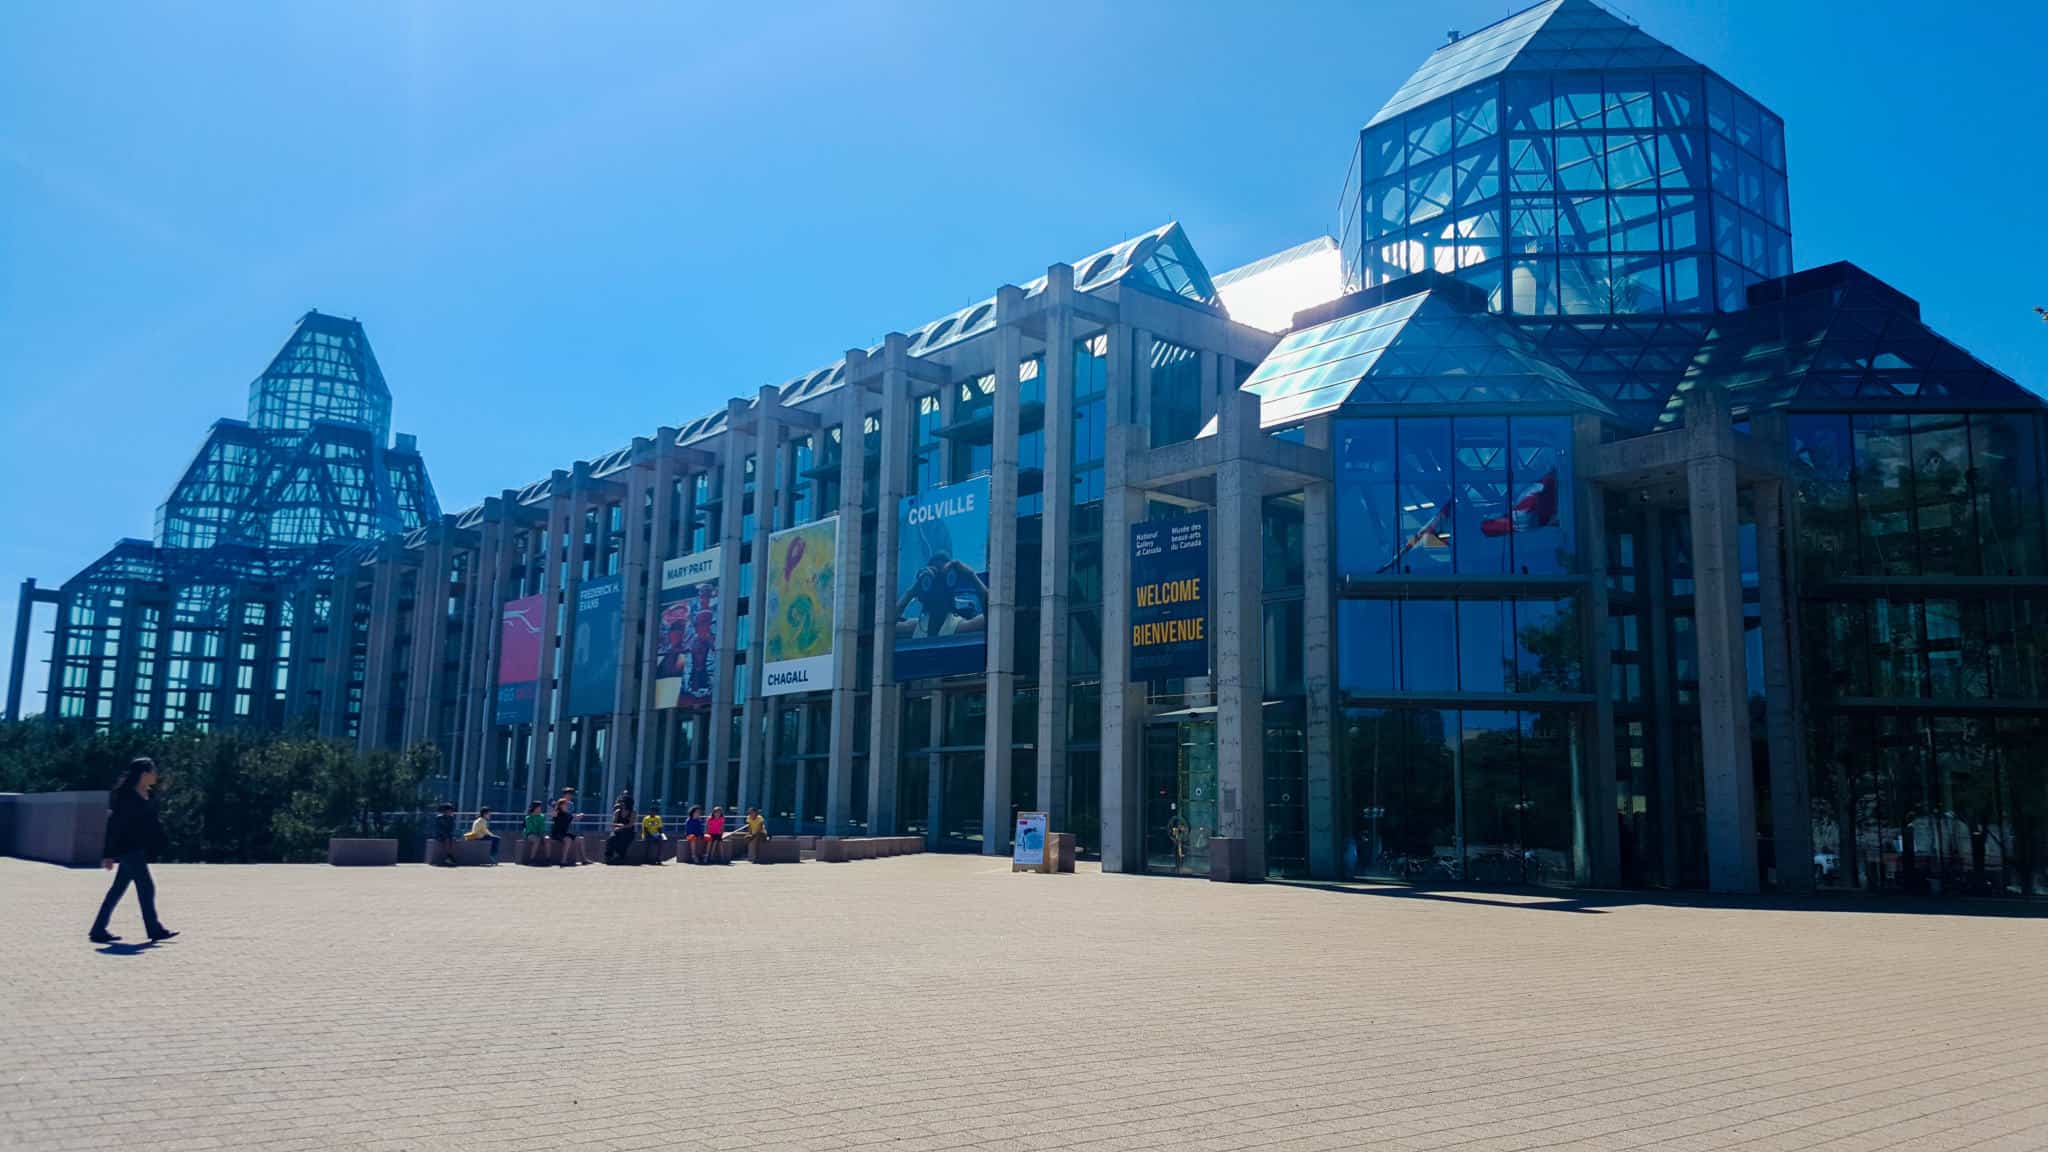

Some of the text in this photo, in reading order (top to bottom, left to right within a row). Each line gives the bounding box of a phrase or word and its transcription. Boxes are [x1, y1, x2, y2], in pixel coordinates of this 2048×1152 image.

[908, 493, 975, 525] COLVILLE
[1191, 523, 1201, 531] des
[1136, 531, 1159, 541] National
[1136, 539, 1154, 550] Gallery
[1142, 546, 1162, 556] Canada
[1170, 539, 1201, 551] du Canada
[667, 560, 712, 579] MARY PRATT
[1136, 578, 1200, 607] WELCOME
[1133, 617, 1204, 647] BIENVENUE
[767, 669, 809, 686] CHAGALL
